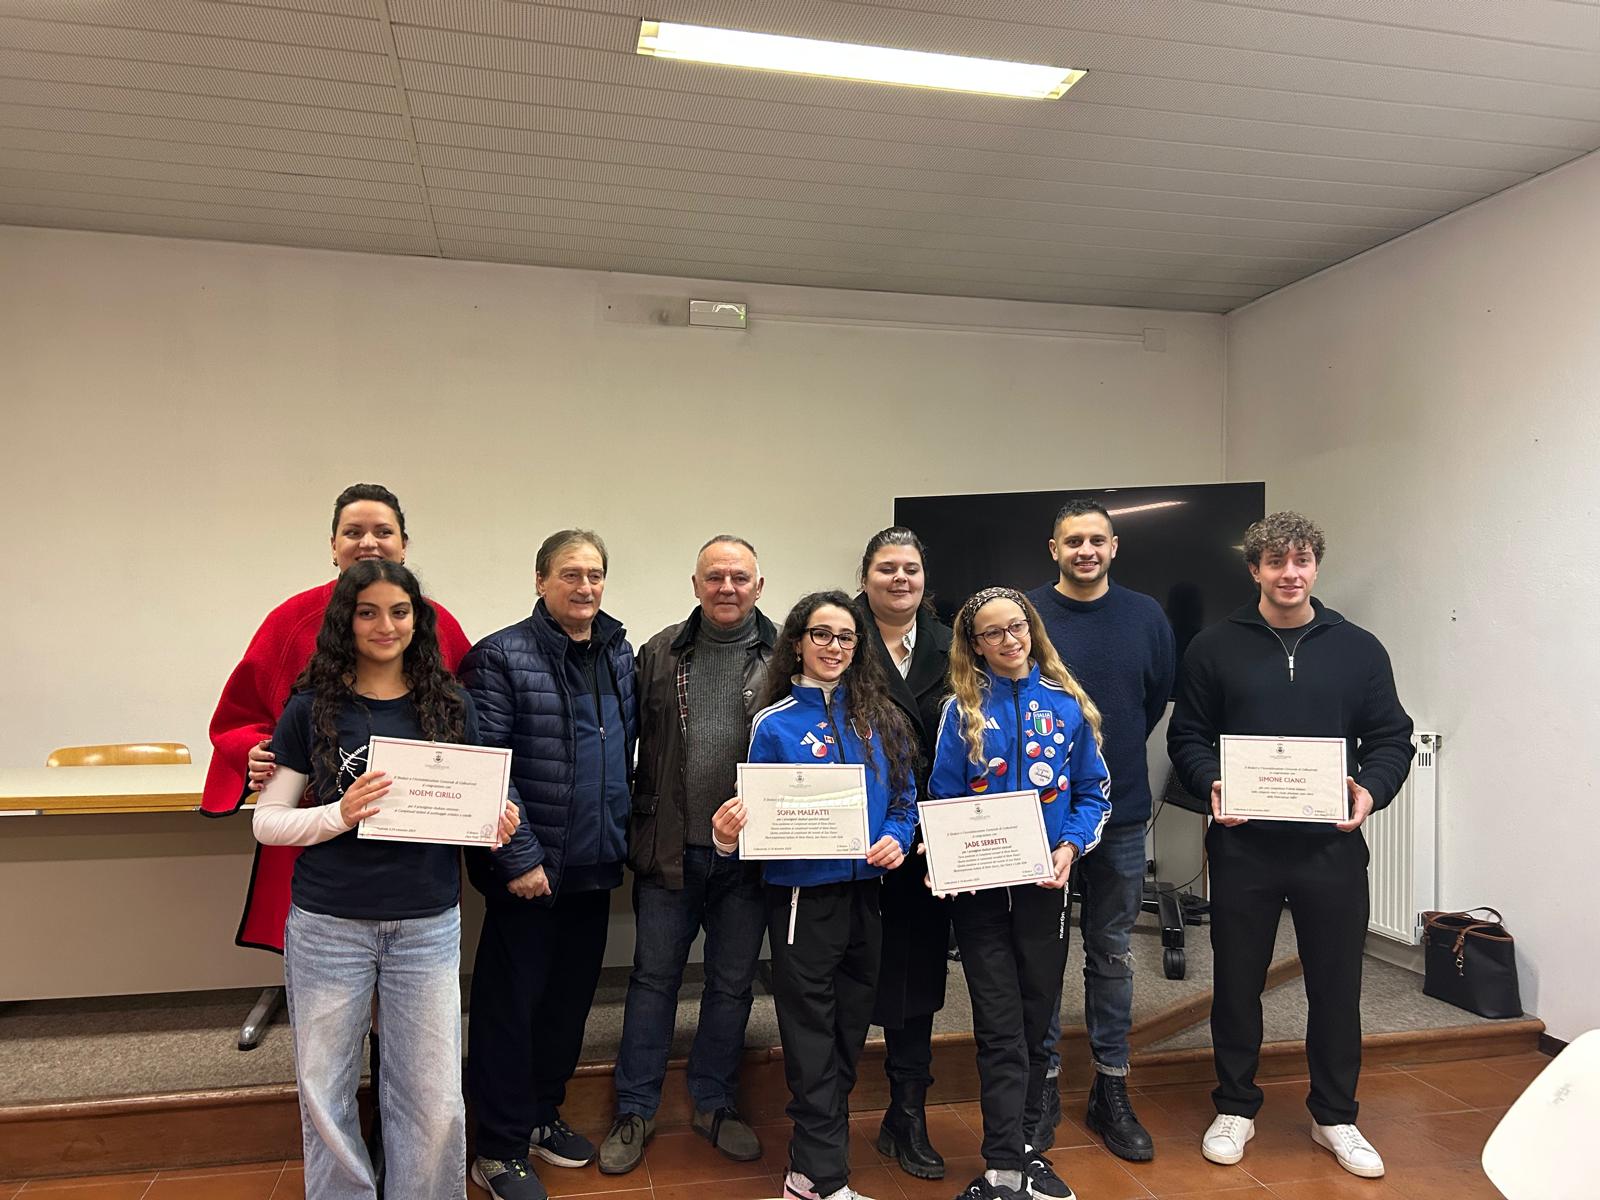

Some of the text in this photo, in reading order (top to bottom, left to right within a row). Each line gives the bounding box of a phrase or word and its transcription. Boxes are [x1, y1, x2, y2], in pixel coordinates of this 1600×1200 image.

[409, 789, 462, 800] NOEMI CIRILLO
[964, 841, 980, 849] JADE
[981, 838, 1008, 847] SERRETTI
